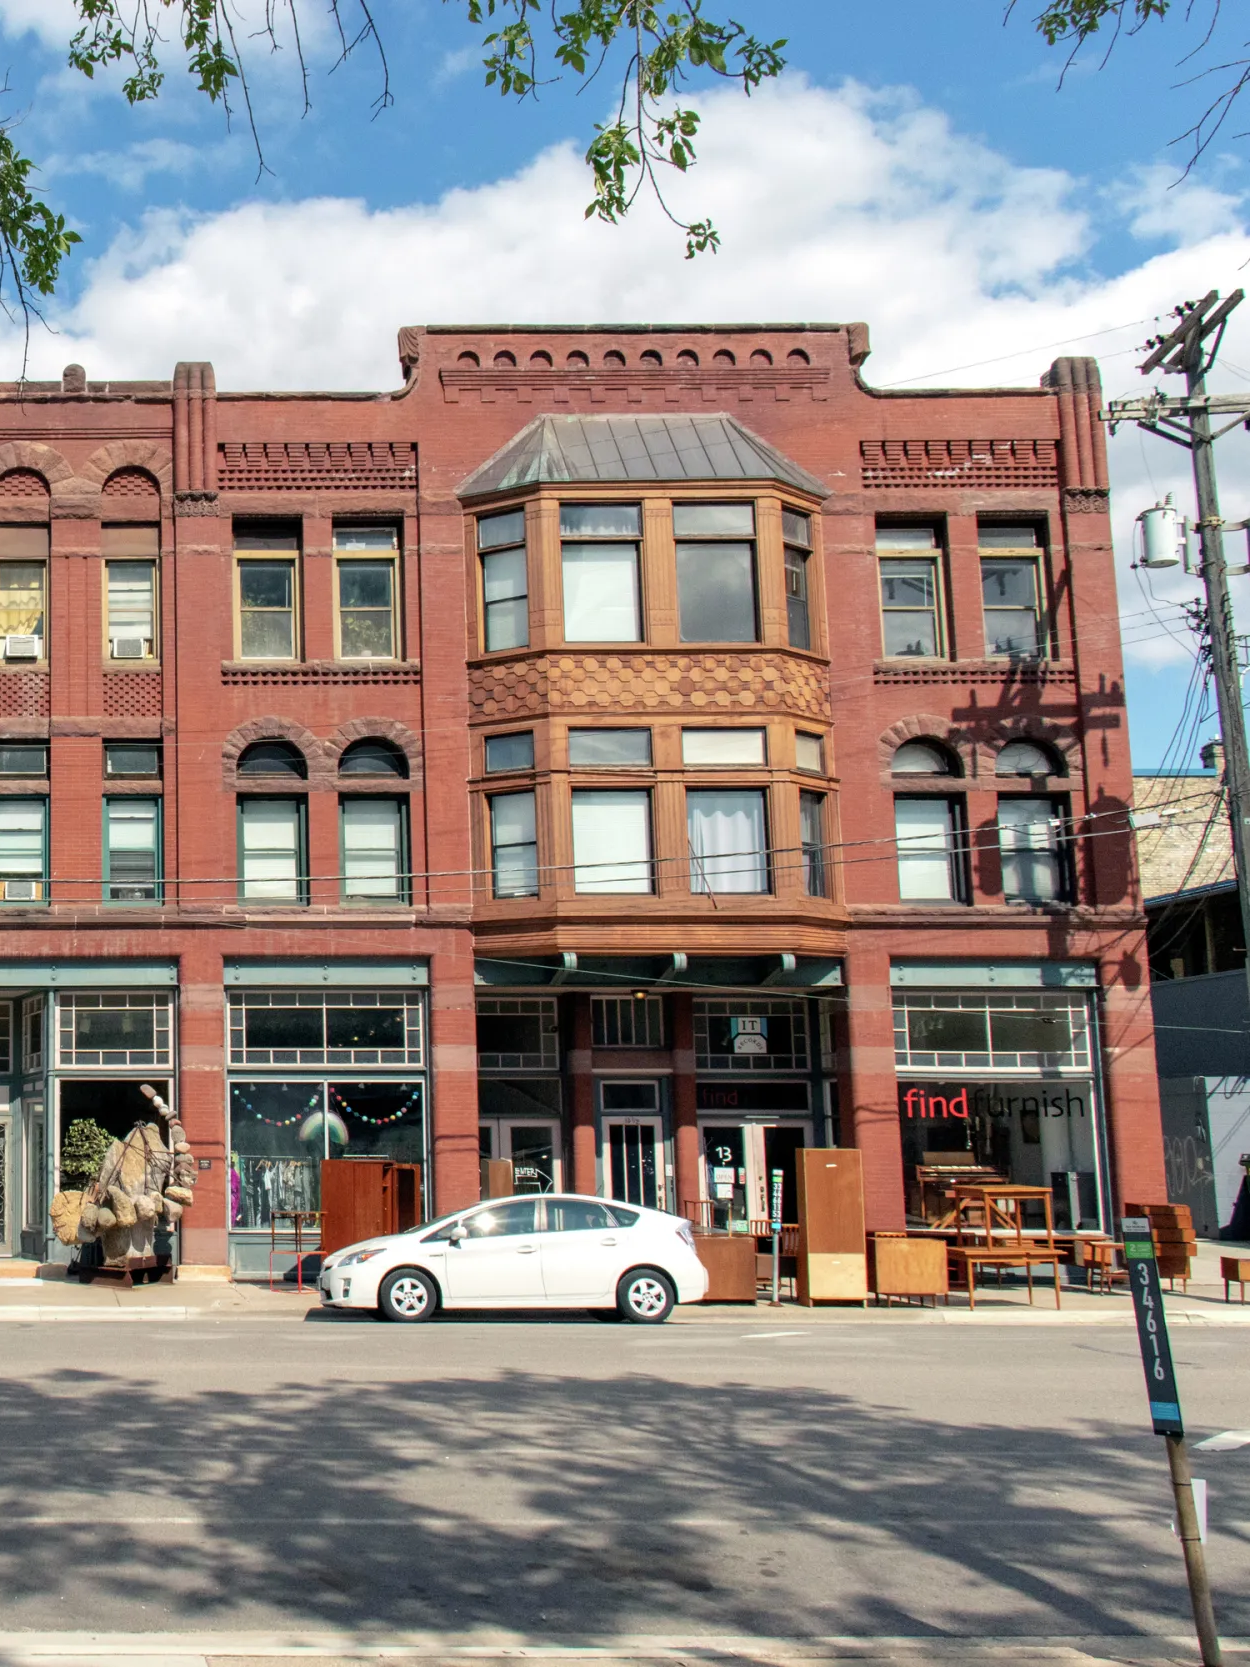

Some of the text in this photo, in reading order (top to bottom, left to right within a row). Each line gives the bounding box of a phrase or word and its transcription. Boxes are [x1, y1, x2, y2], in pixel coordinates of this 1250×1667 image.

[742, 1020, 758, 1031] IT
[737, 1038, 764, 1051] RECORDS
[703, 1088, 739, 1107] find
[903, 1087, 1086, 1118] find furnish
[715, 1146, 733, 1162] 13
[514, 1167, 537, 1176] ENTER
[1130, 1243, 1137, 1252] 2
[1137, 1263, 1165, 1381] 34616
